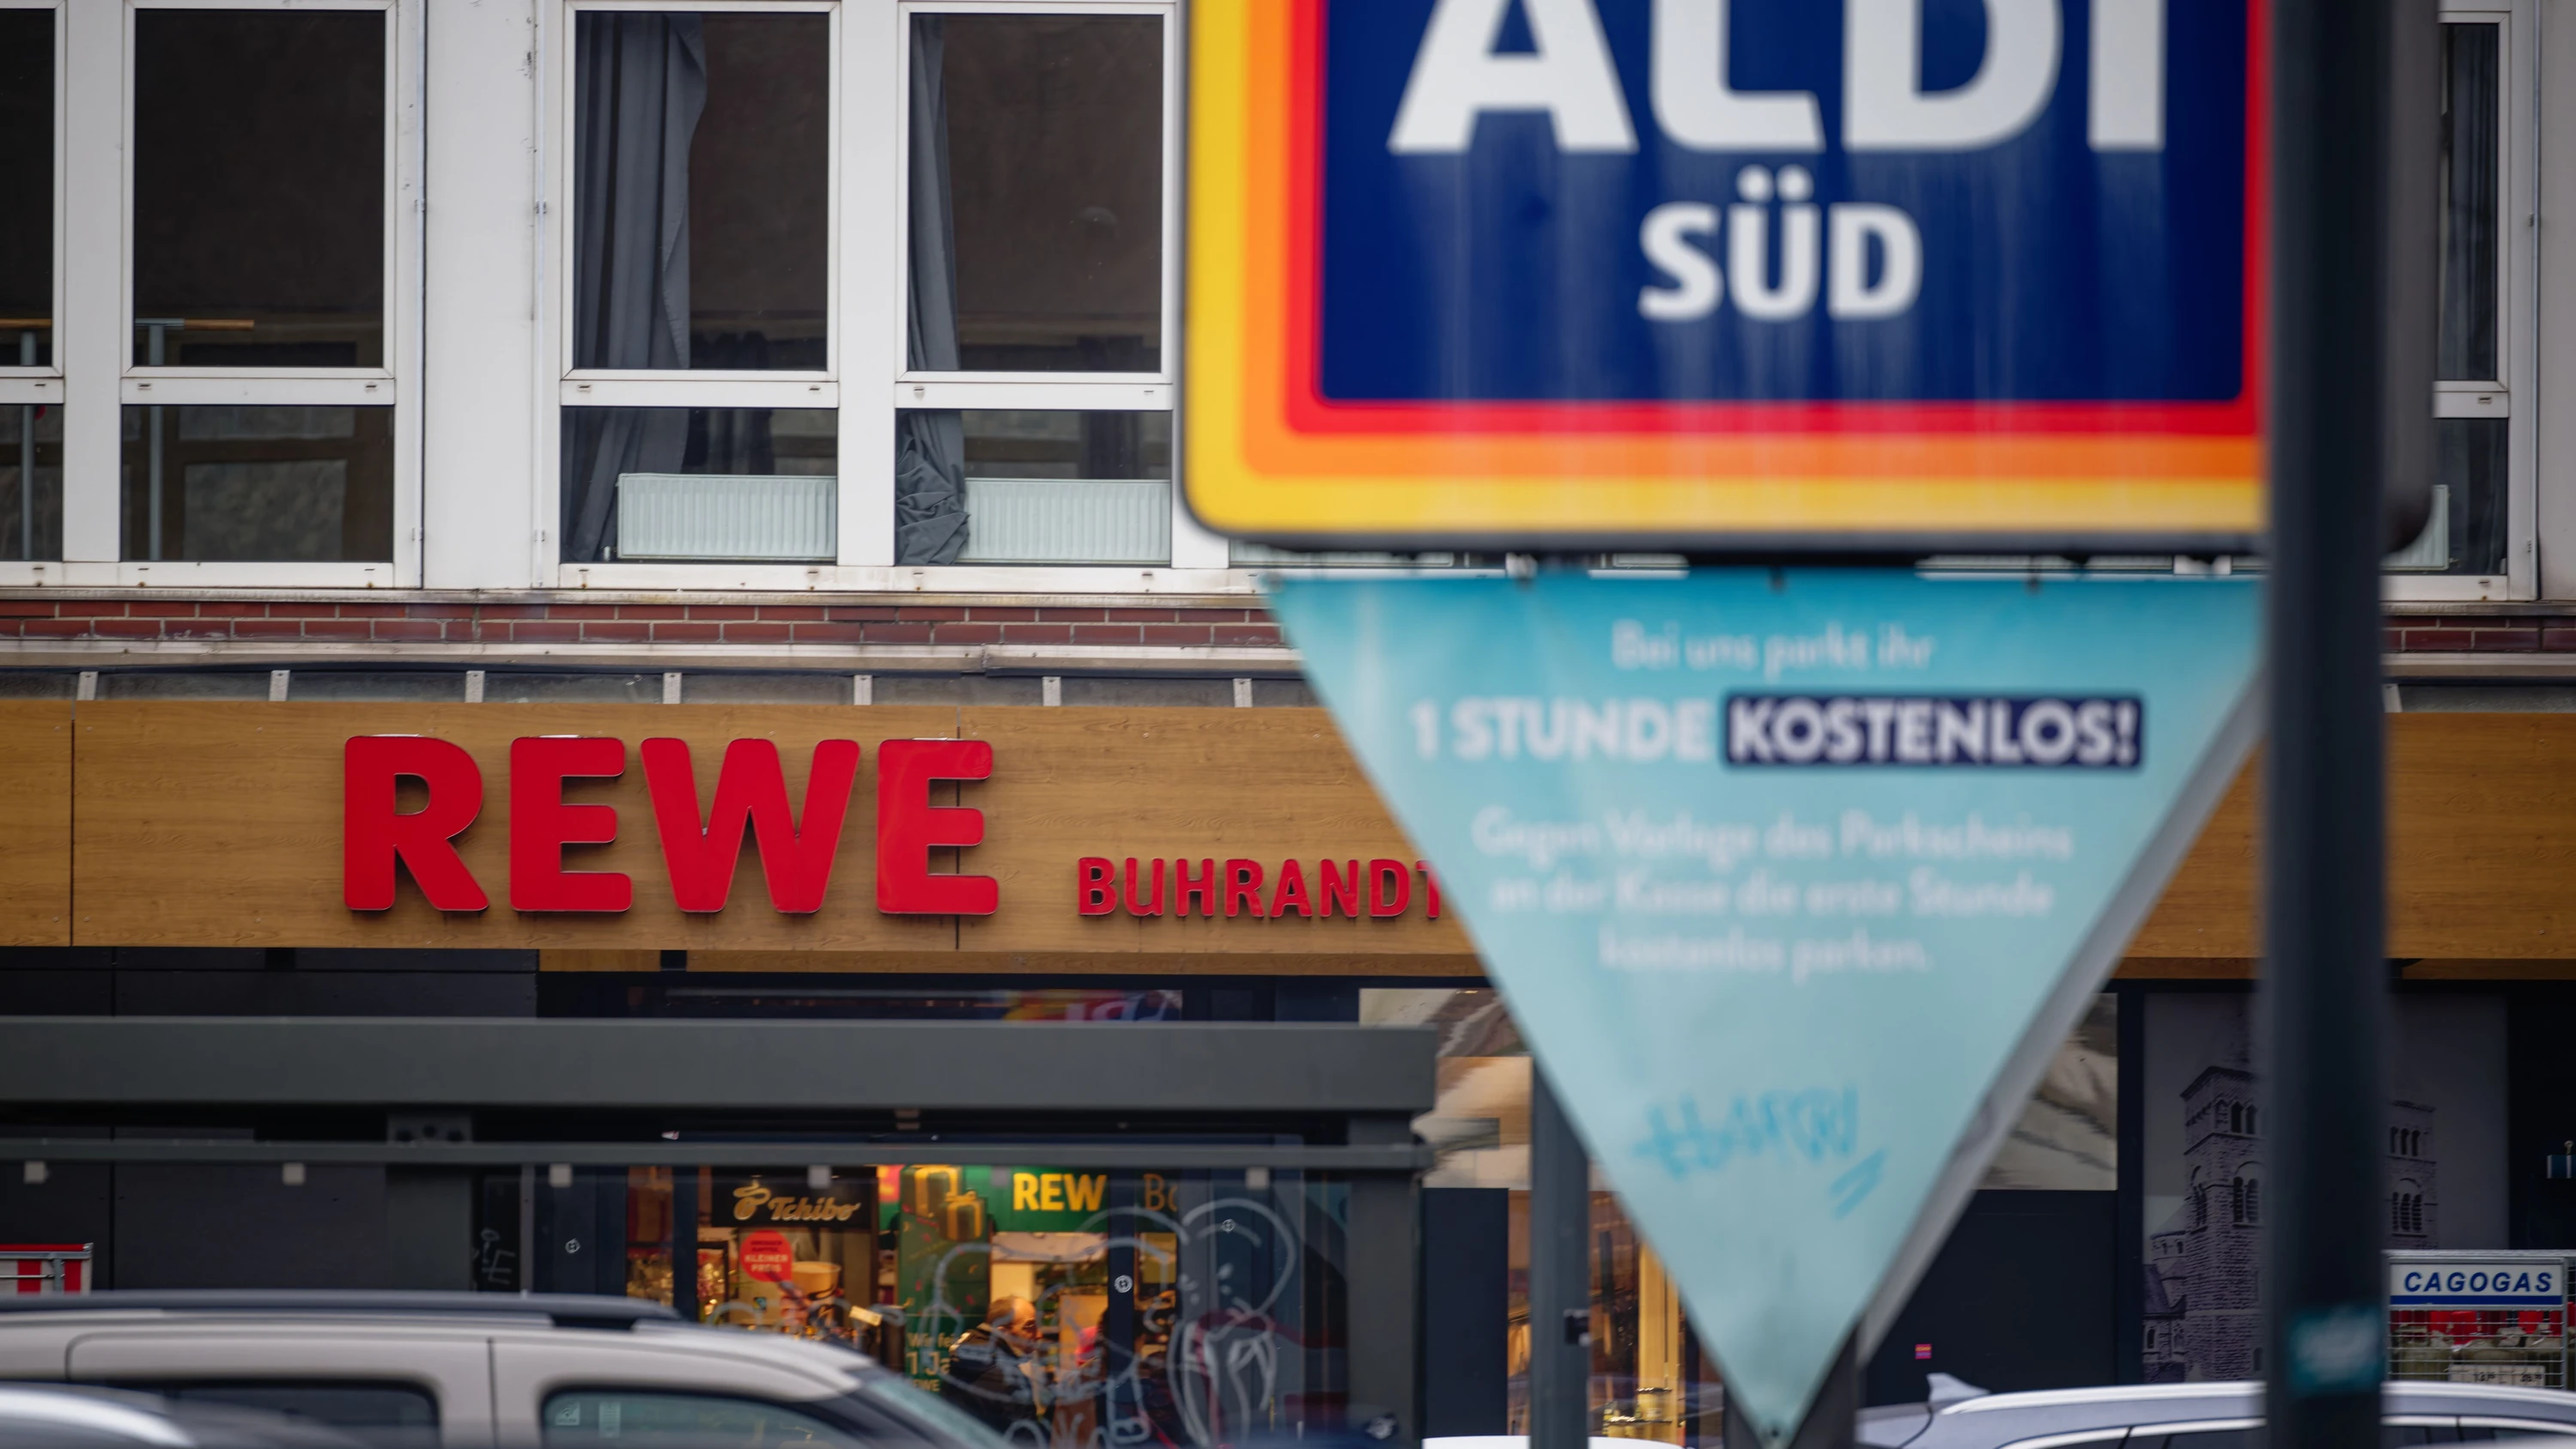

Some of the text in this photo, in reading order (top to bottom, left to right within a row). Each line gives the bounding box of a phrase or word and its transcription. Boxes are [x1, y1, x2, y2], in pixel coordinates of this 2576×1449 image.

[1388, 0, 2166, 152] ALDI
[1637, 166, 1922, 321] SÜD
[1611, 619, 1936, 683] Bei uns parkt ihr
[1411, 697, 2137, 762] 1 STUNDE KOSTENLOS!
[343, 736, 999, 915] REWE
[1472, 807, 2075, 871] Gegen Vorlage des Parkscheins
[1078, 857, 1441, 918] BUHRANDT
[1614, 870, 1728, 913] Kasse
[1909, 868, 2053, 915] Stunde
[1600, 925, 1783, 972] kostenlos
[768, 1197, 861, 1221] Tchibo
[1012, 1173, 1108, 1212] REW
[2403, 1271, 2554, 1293] CAGOGAS
[924, 1351, 951, 1375] Ja
